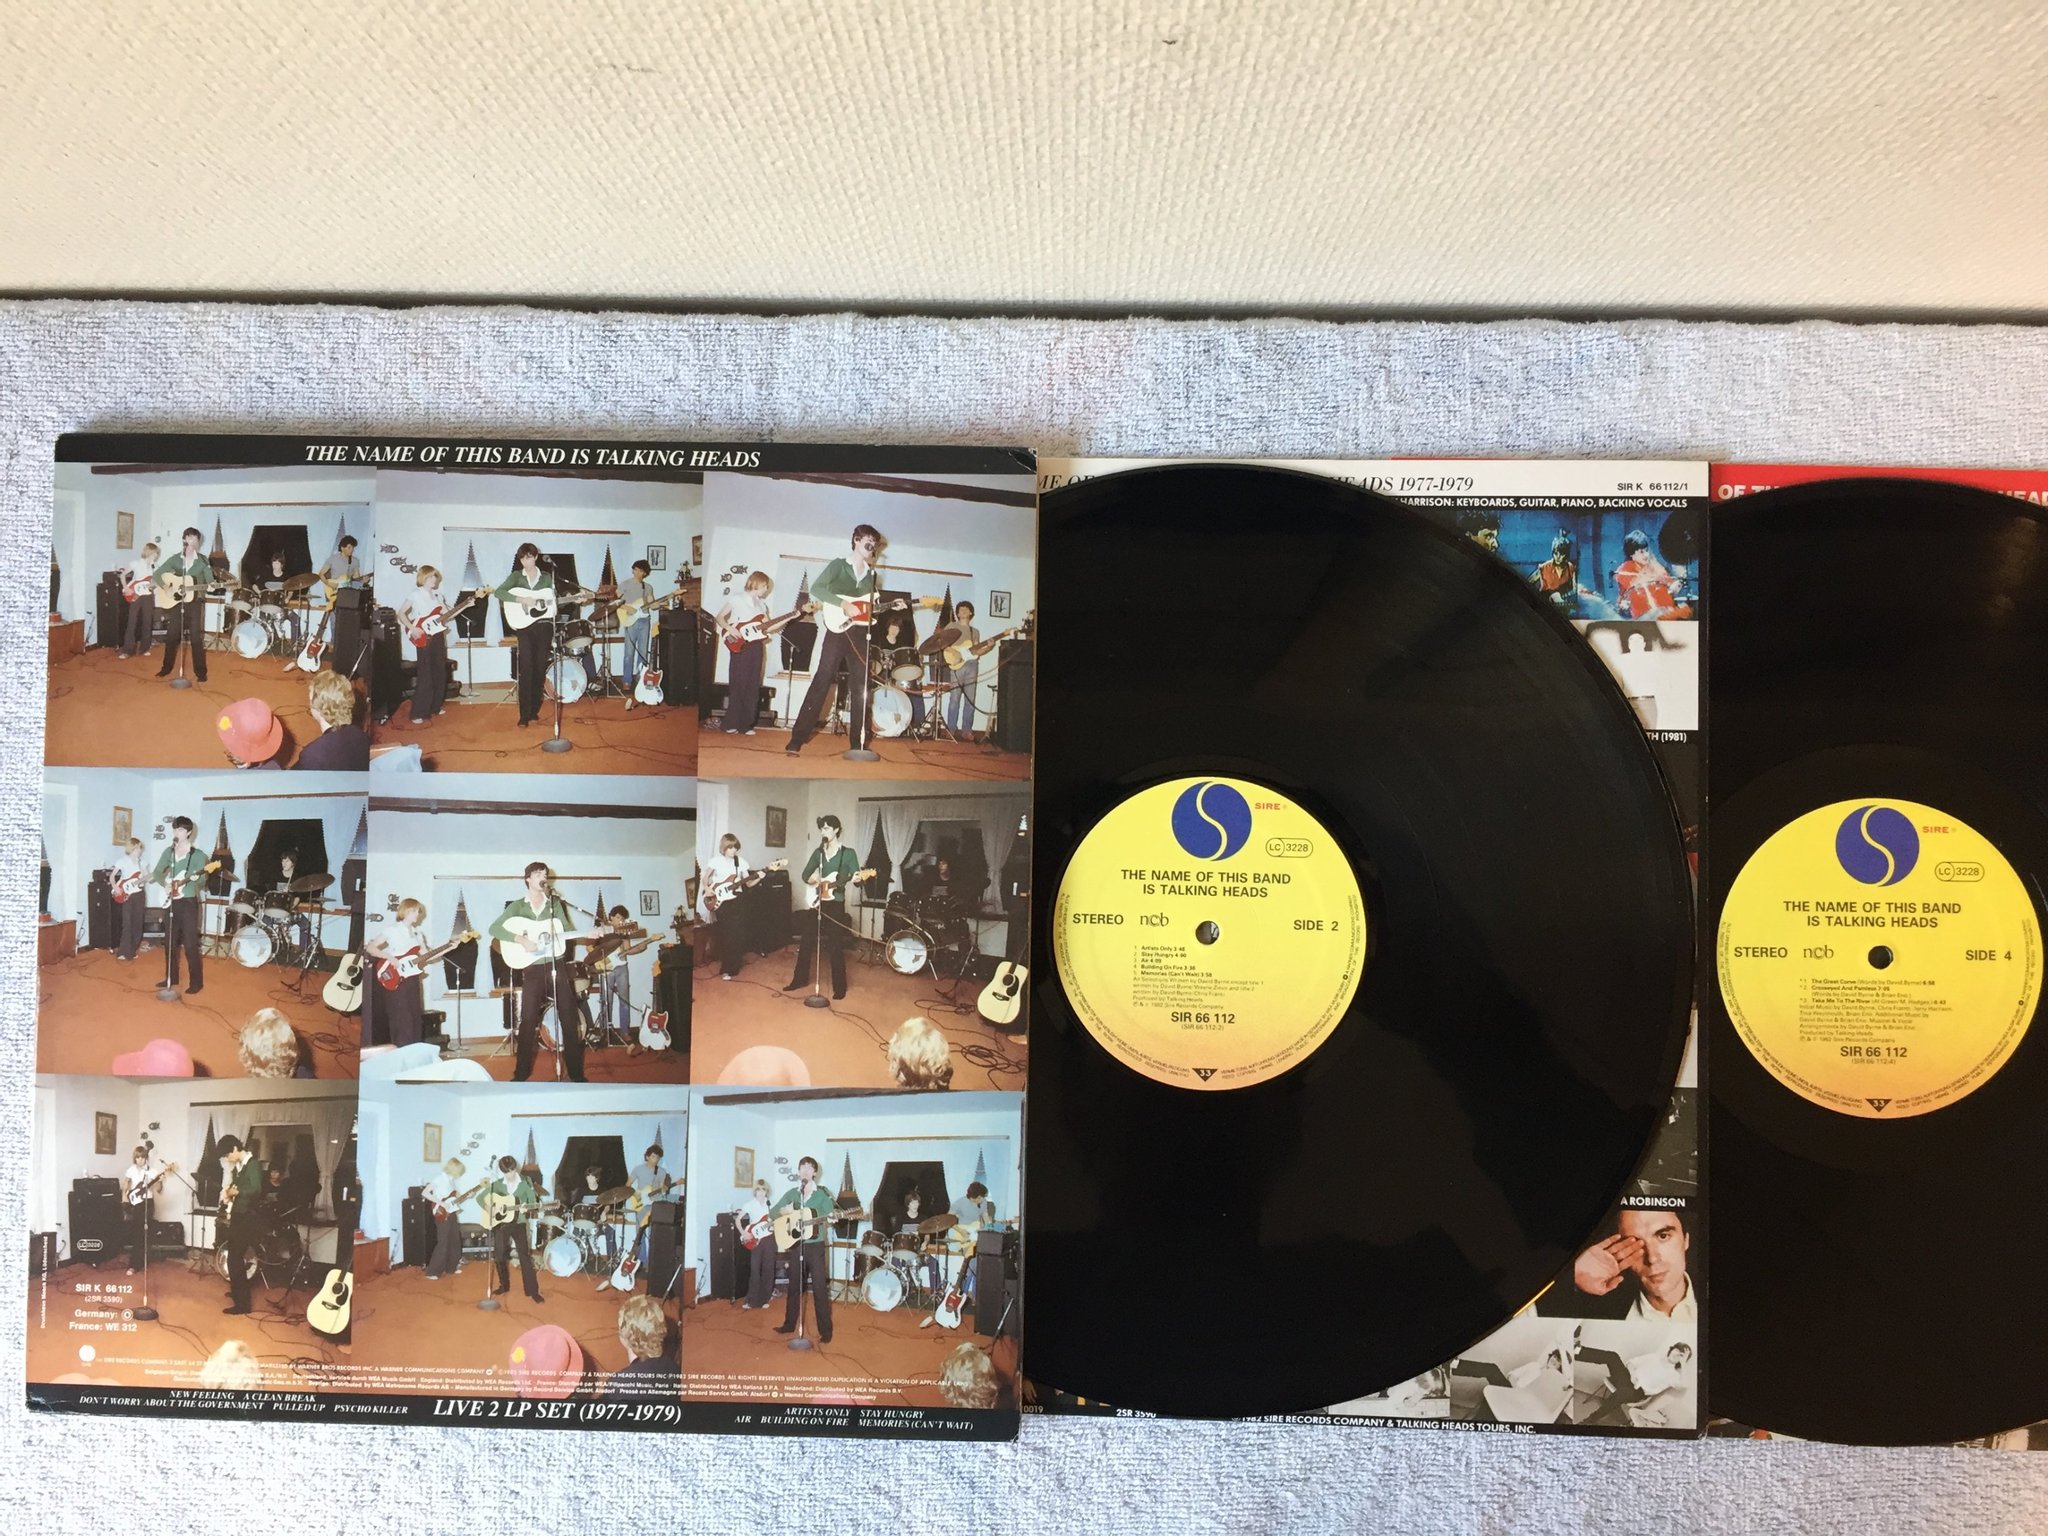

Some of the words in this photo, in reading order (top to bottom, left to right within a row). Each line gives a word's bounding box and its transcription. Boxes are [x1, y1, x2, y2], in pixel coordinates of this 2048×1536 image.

[305, 445, 347, 461] THE
[352, 445, 414, 463] NAME
[419, 446, 450, 463] OF
[454, 446, 502, 464] THIS
[507, 447, 566, 465] BAND
[570, 447, 590, 465] IS
[595, 448, 685, 467] TALKING
[690, 449, 761, 468] HEADS
[1399, 476, 1474, 492] 1977-1979
[1617, 482, 1633, 491] SIR
[1636, 482, 1643, 491] K
[1400, 497, 1454, 507] HARRISON:
[1456, 497, 1518, 508] KEYBOARDS,
[1519, 498, 1560, 508] GUITAR,
[1560, 498, 1597, 509] PIANO,
[1598, 498, 1646, 508] BACKING
[1646, 498, 1688, 509] VOCALS
[1661, 732, 1687, 744] (1981)
[1254, 802, 1281, 811] SIRE
[1922, 826, 1949, 834] SIRE
[1269, 843, 1282, 852] LC
[1286, 843, 1309, 852] 3228
[1121, 869, 1146, 880] THE
[1151, 870, 1191, 882] NAME
[1196, 871, 1214, 883] OF
[1218, 872, 1248, 883] THIS
[1253, 873, 1291, 884] BAND
[1938, 867, 1951, 876] LC
[1956, 867, 1980, 876] 3228
[1143, 883, 1155, 895] IS
[1160, 884, 1218, 896] TALKING
[1223, 886, 1269, 898] HEADS
[1783, 901, 1810, 912] THE
[1815, 901, 1857, 913] NAME
[1862, 902, 1880, 913] OF
[1885, 902, 1917, 914] THIS
[1922, 903, 1962, 914] BAND
[1072, 913, 1125, 925] STEREO
[1293, 919, 1324, 931] SIDE
[1331, 920, 1339, 931] 2
[1807, 916, 1820, 927] IS
[1825, 916, 1885, 928] TALKING
[1891, 917, 1938, 928] HEADS
[1734, 946, 1788, 958] STEREO
[1965, 950, 1996, 961] SIDE
[2004, 950, 2012, 961] 4
[1170, 1011, 1192, 1023] SIR
[1195, 1012, 1210, 1024] 66
[1214, 1013, 1236, 1024] 112
[1840, 1045, 1863, 1057] SIR
[1865, 1046, 1881, 1057] 66
[1887, 1047, 1908, 1058] 112
[1629, 1196, 1686, 1207] ROBINSON
[75, 1283, 92, 1293] SIR
[94, 1284, 101, 1293] K
[74, 1308, 118, 1320] Germany:
[69, 1321, 103, 1331] France:
[105, 1322, 120, 1331] WE
[122, 1323, 138, 1332] 312
[169, 1390, 192, 1399] NEW
[192, 1391, 235, 1400] FEELING
[243, 1393, 250, 1401] A
[251, 1393, 284, 1401] CLEAN
[284, 1394, 317, 1403] BREAK
[79, 1396, 107, 1405] DON'T
[109, 1397, 142, 1406] WORRY
[143, 1398, 175, 1407] ABOUT
[176, 1399, 197, 1408] THE
[198, 1400, 265, 1410] GOVERNMENT
[272, 1402, 312, 1412] PULLED
[312, 1404, 326, 1412] UP
[334, 1404, 372, 1413] PSYCHO
[372, 1405, 409, 1414] KILLER
[1023, 1405, 1044, 1413] 0019
[432, 1399, 485, 1416] LIVE
[487, 1400, 500, 1417] 2
[503, 1401, 532, 1418] LP
[534, 1401, 576, 1419] SET
[579, 1402, 682, 1426] (1977-1979)
[783, 1407, 824, 1416] ARTISTS
[825, 1408, 852, 1417] ONLY
[859, 1409, 883, 1418] STAY
[883, 1410, 926, 1419] HUNGRY
[1115, 1408, 1134, 1417] 2SR
[734, 1415, 752, 1424] AIR
[760, 1416, 809, 1425] BUILDING
[809, 1417, 825, 1425] ON
[825, 1417, 850, 1427] FIRE
[857, 1418, 912, 1428] MEMORIES
[911, 1420, 945, 1429] (CAN'T
[945, 1420, 974, 1431] WAIT)
[1263, 1414, 1284, 1423] SIRE
[1285, 1415, 1332, 1425] RECORDS
[1333, 1416, 1386, 1427] COMPANY
[1386, 1419, 1394, 1428] &
[1396, 1419, 1440, 1429] TALKING
[1441, 1421, 1475, 1431] HEADS
[1476, 1423, 1513, 1433] TOURS,
[1514, 1425, 1537, 1434] INC.
